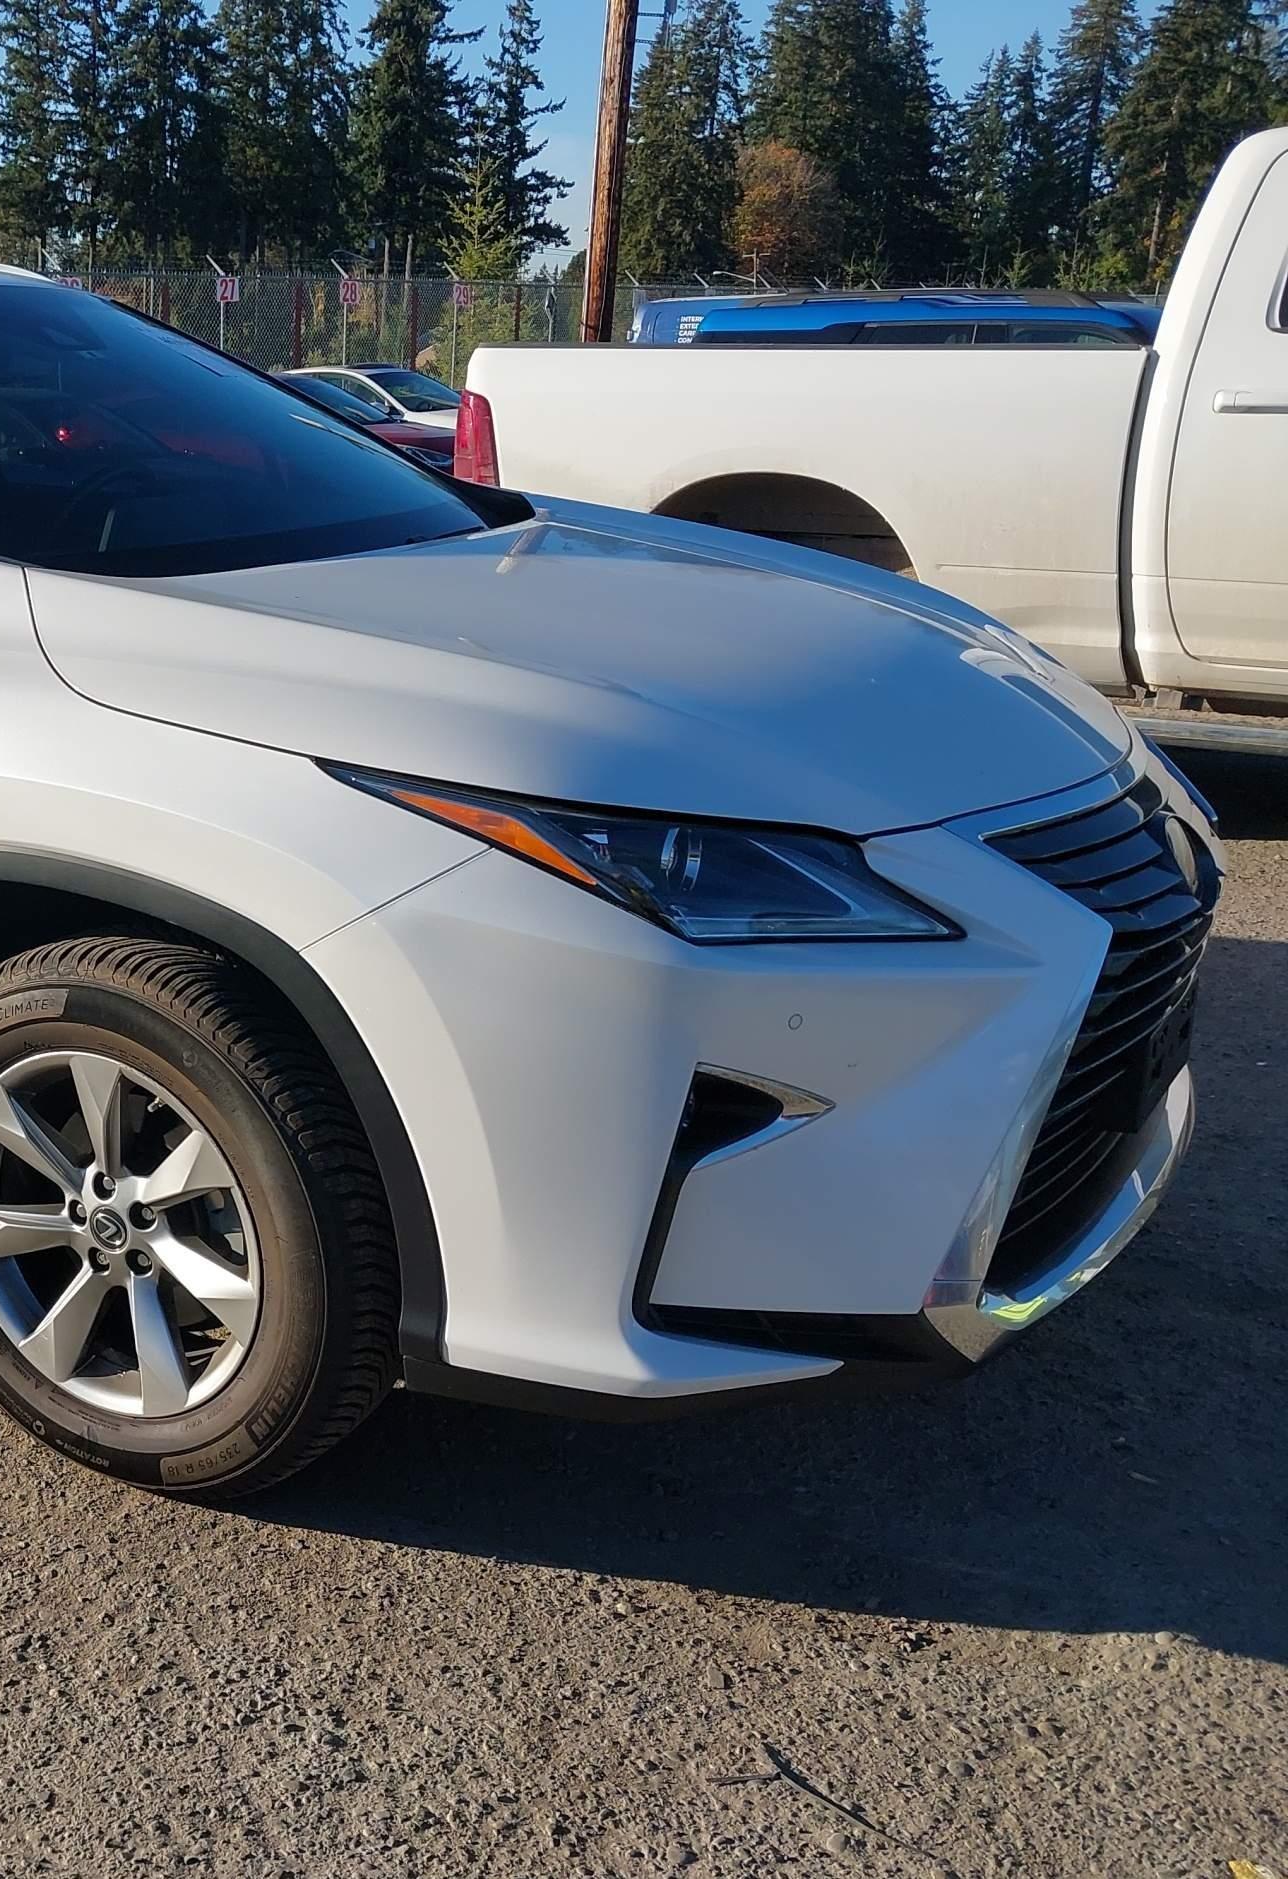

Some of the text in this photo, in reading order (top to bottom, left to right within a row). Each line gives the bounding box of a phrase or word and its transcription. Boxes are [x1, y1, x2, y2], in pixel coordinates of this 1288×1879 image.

[220, 279, 235, 301] 27
[342, 282, 357, 302] 28
[455, 286, 469, 304] 29
[63, 1443, 111, 1469] ROTATION
[167, 1442, 241, 1476] 235/65 R 18
